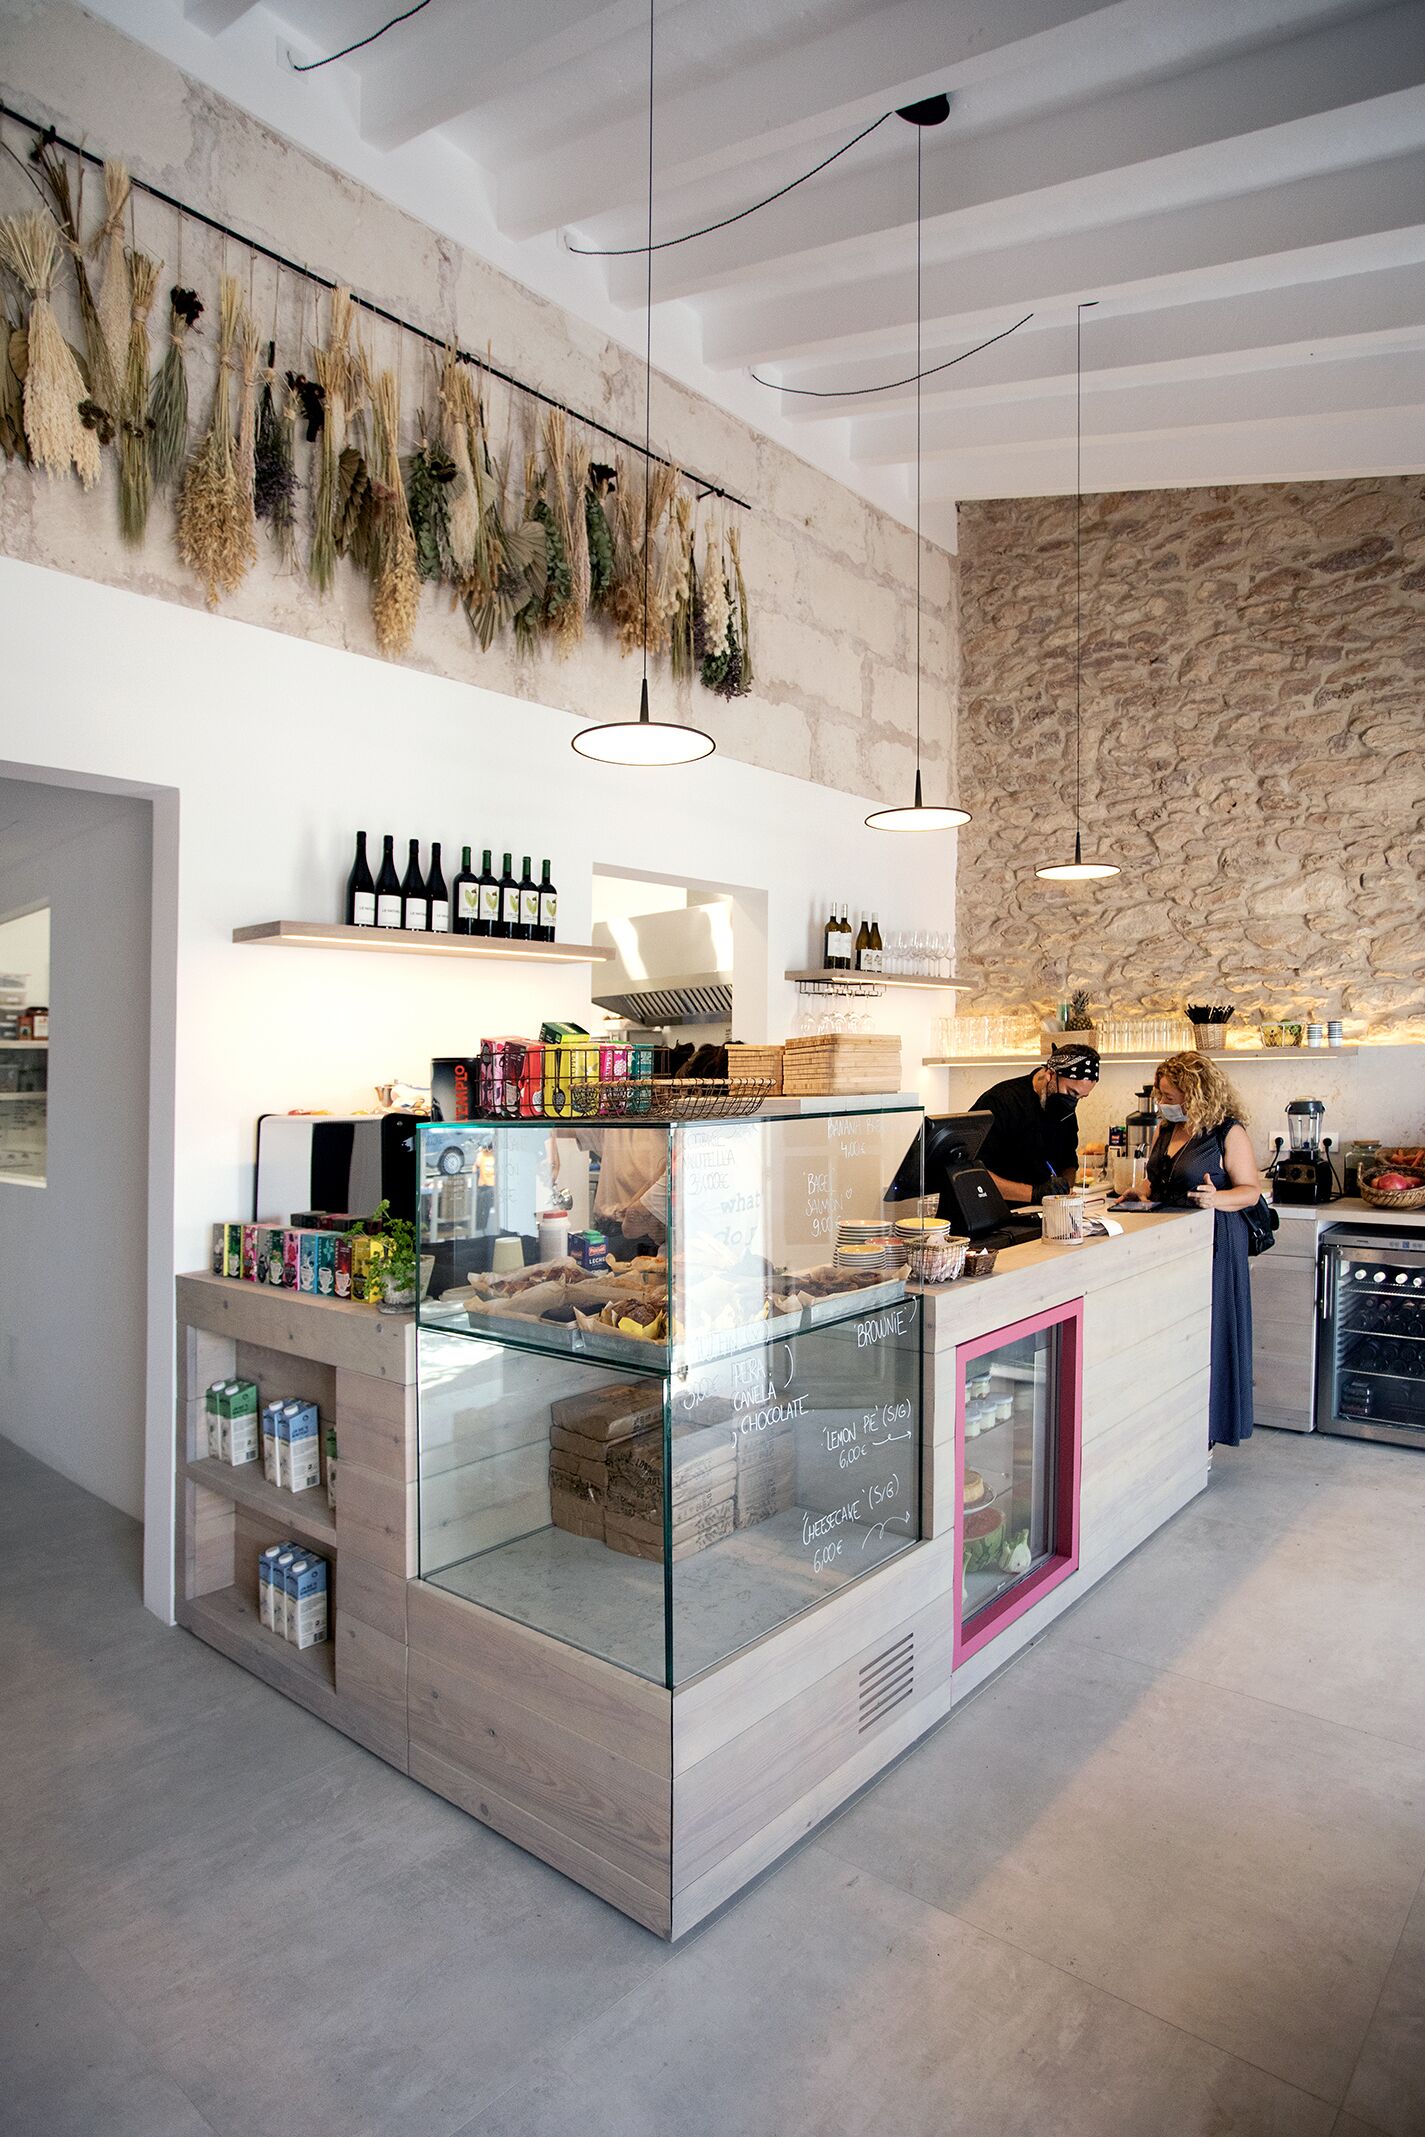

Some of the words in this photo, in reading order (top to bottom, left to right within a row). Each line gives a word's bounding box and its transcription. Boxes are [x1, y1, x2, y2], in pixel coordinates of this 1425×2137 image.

[720, 1192, 761, 1214] what
[733, 1381, 777, 1412] CANELA
[839, 1444, 867, 1469] 6,00€
[813, 1539, 843, 1573] 6,00€
